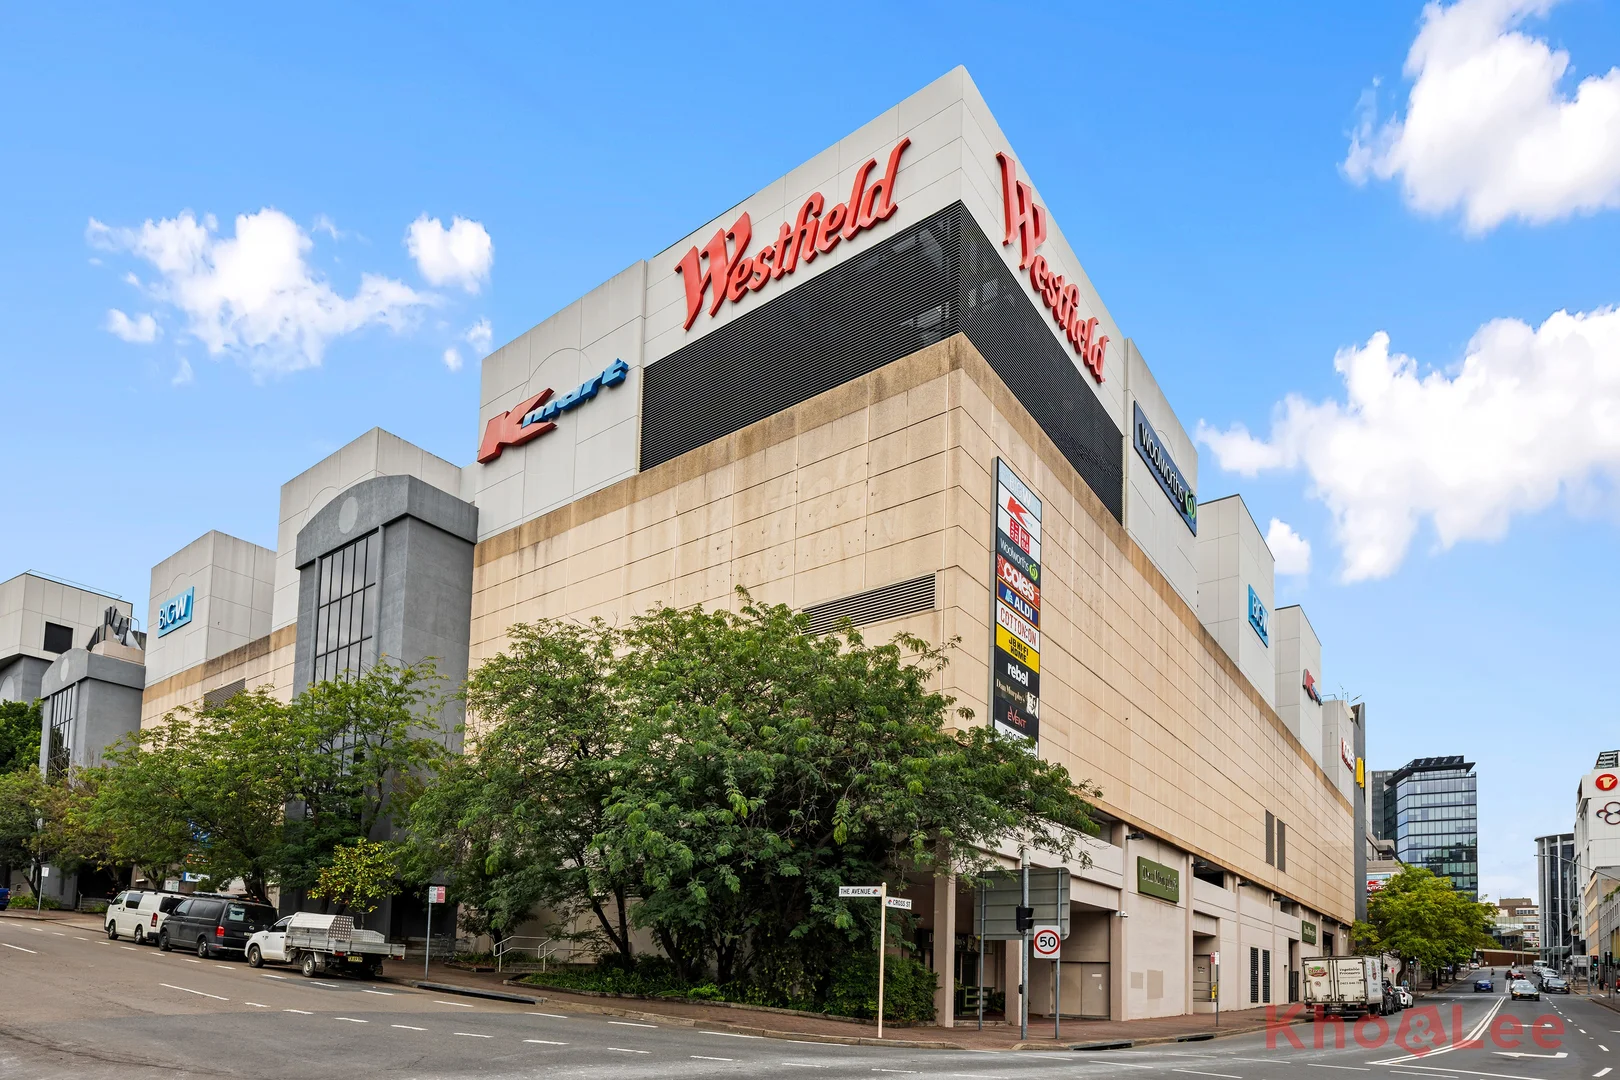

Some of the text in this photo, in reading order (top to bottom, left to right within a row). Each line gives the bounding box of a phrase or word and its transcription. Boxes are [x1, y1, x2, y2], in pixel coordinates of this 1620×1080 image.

[674, 137, 911, 332] Westfield
[996, 151, 1109, 383] Westfield
[477, 358, 629, 464] Kmart
[1140, 423, 1184, 504] Woolworths
[1003, 563, 1035, 602] coles
[1014, 596, 1033, 621] ALDI
[1009, 637, 1028, 656] JB HI-FI
[1010, 645, 1026, 663] HOME
[1007, 662, 1029, 687] rebel
[893, 899, 905, 907] CROSS
[1039, 937, 1056, 948] 50
